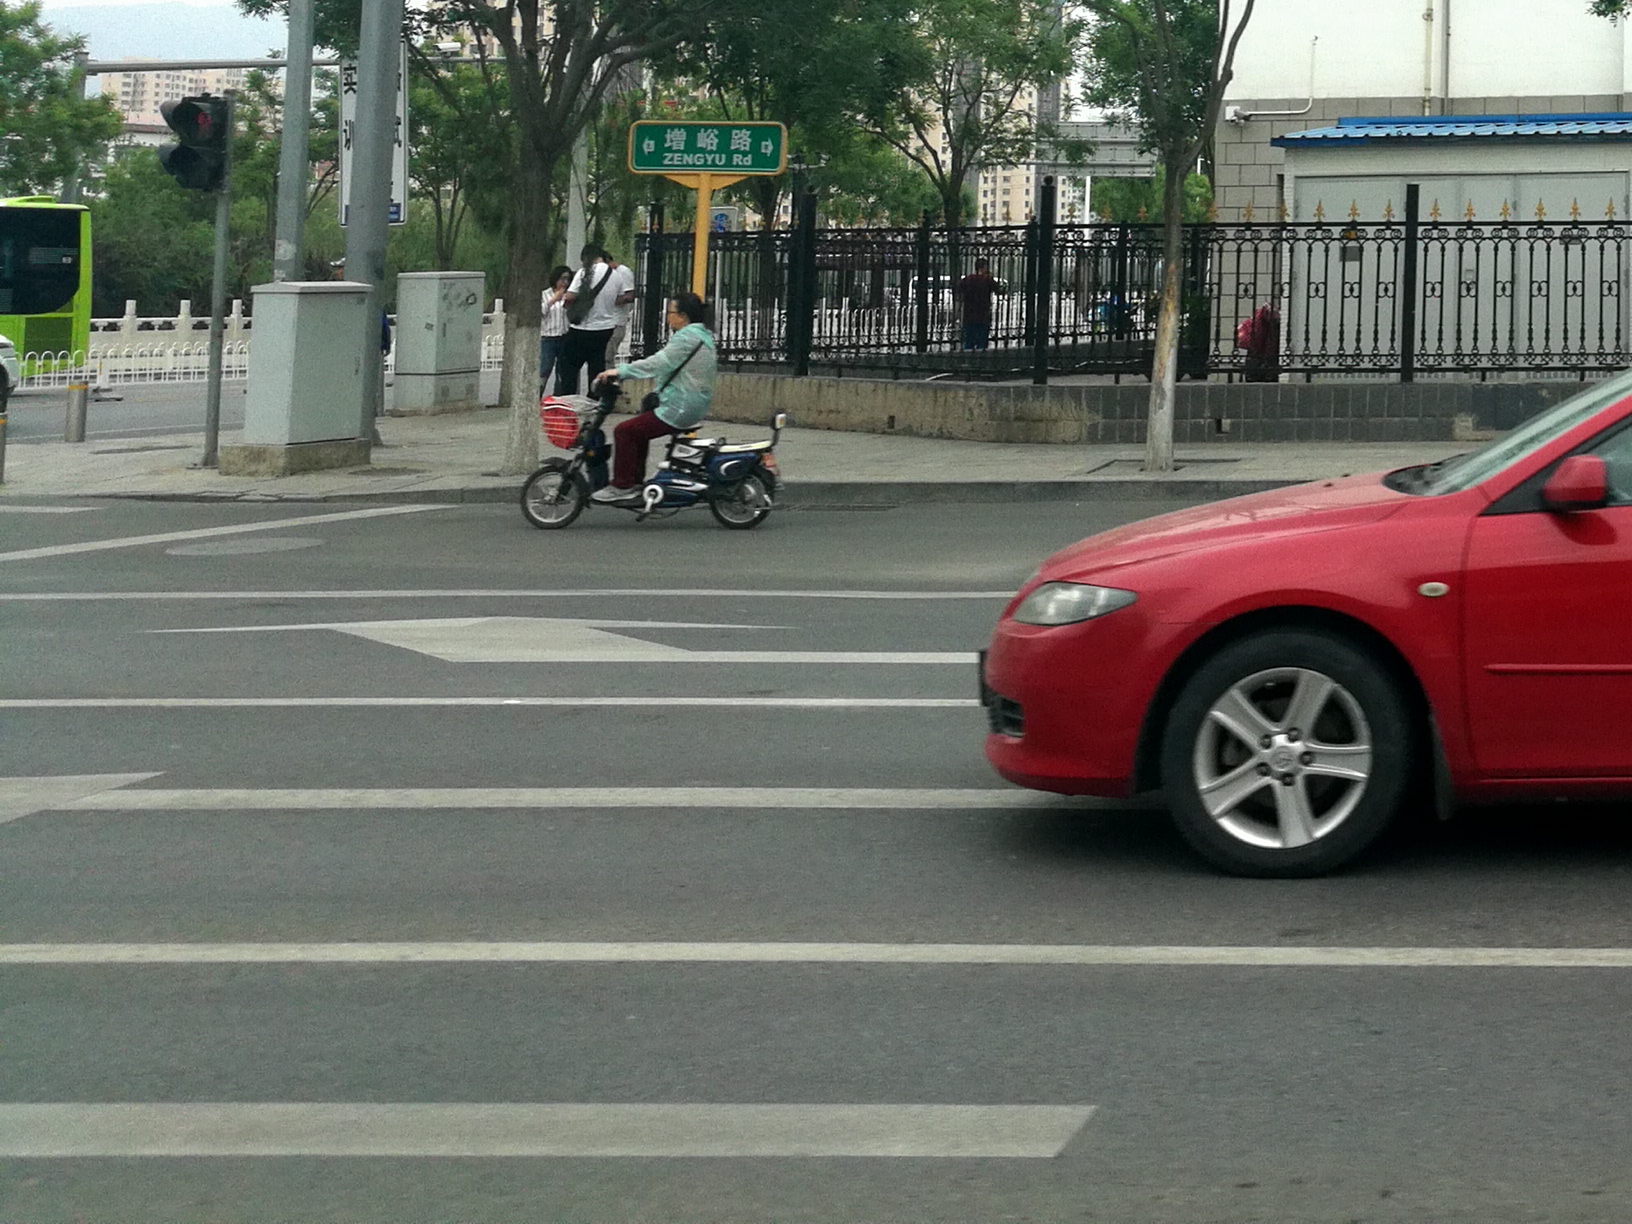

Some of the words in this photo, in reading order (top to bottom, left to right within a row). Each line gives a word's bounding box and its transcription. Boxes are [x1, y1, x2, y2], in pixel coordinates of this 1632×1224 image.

[664, 128, 752, 151] 增峪路
[664, 153, 725, 165] ZENGYU
[732, 154, 752, 166] Rd
